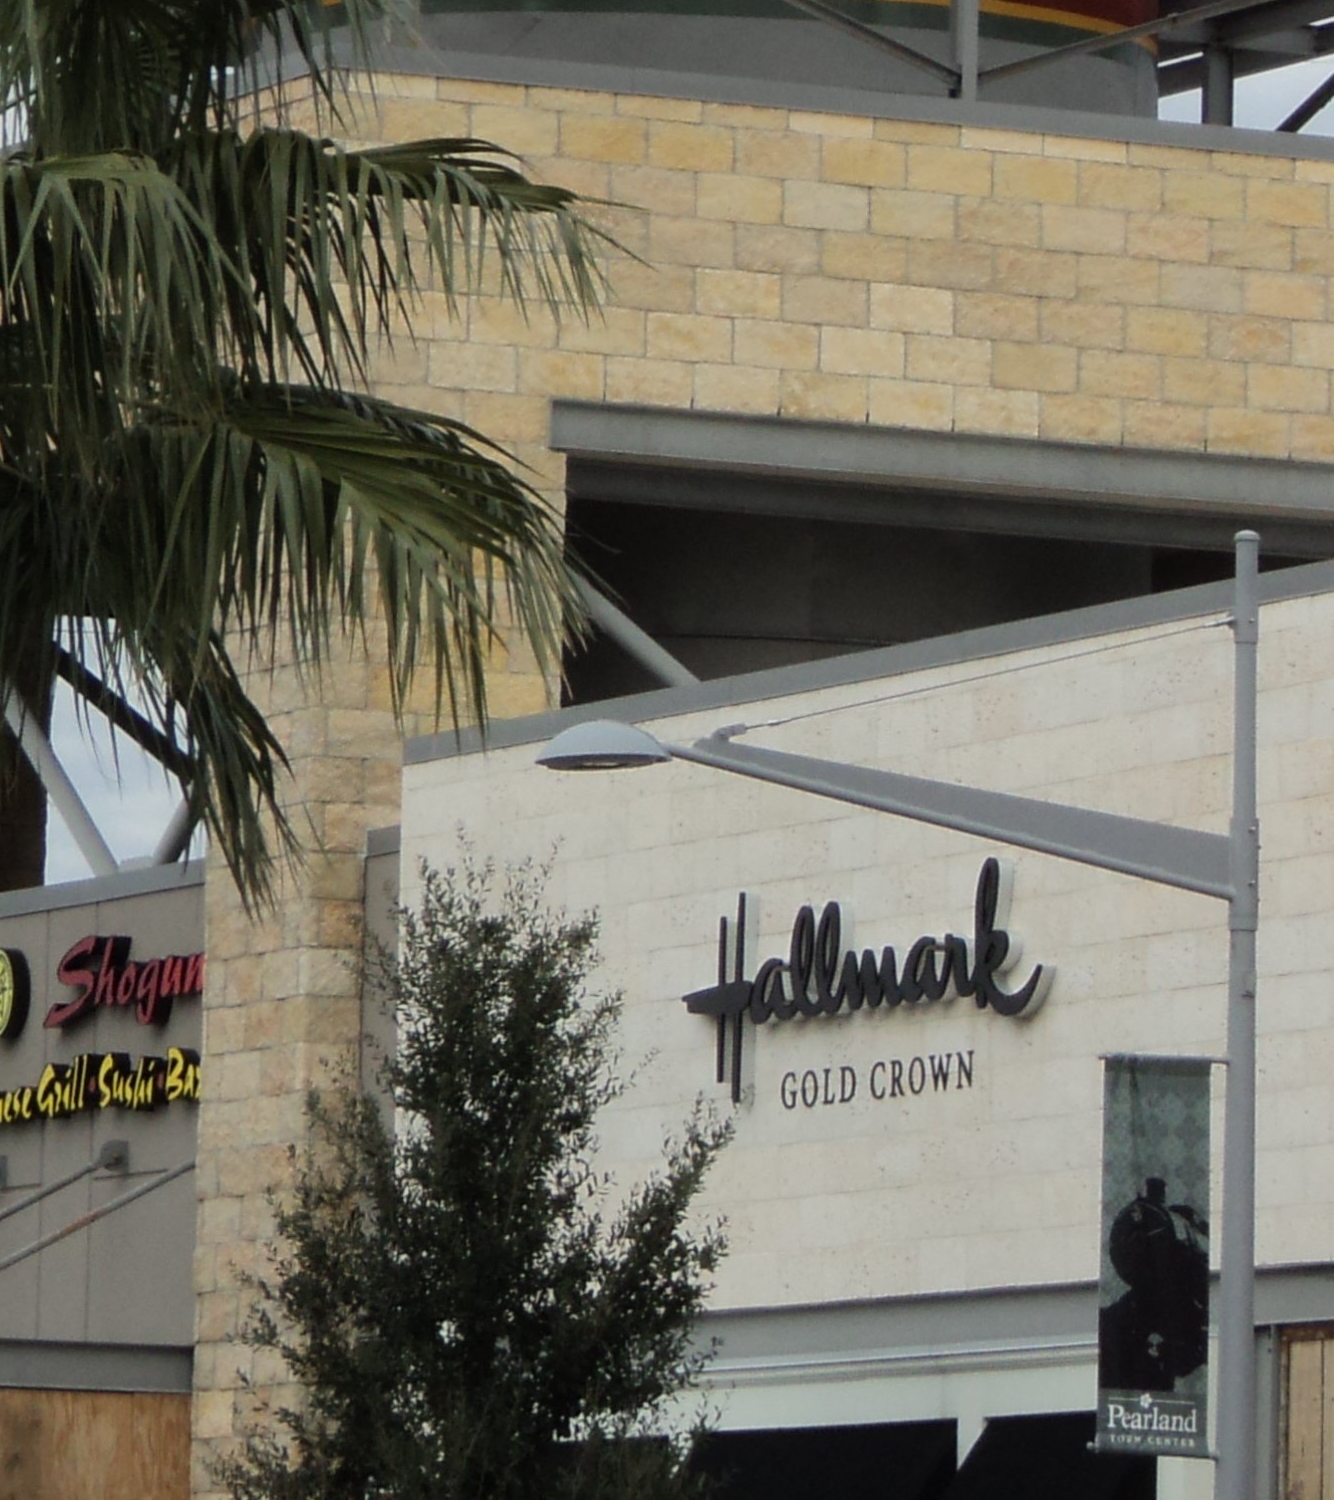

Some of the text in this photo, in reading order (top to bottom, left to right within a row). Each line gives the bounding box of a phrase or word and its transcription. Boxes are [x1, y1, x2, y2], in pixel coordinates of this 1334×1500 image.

[43, 935, 206, 1028] Shogun
[681, 856, 1045, 1105] Hallmark
[37, 1053, 89, 1118] Grill
[98, 1052, 157, 1110] Sushi
[780, 1050, 976, 1110] GOLD CROWN
[1107, 1404, 1197, 1432] Pearland
